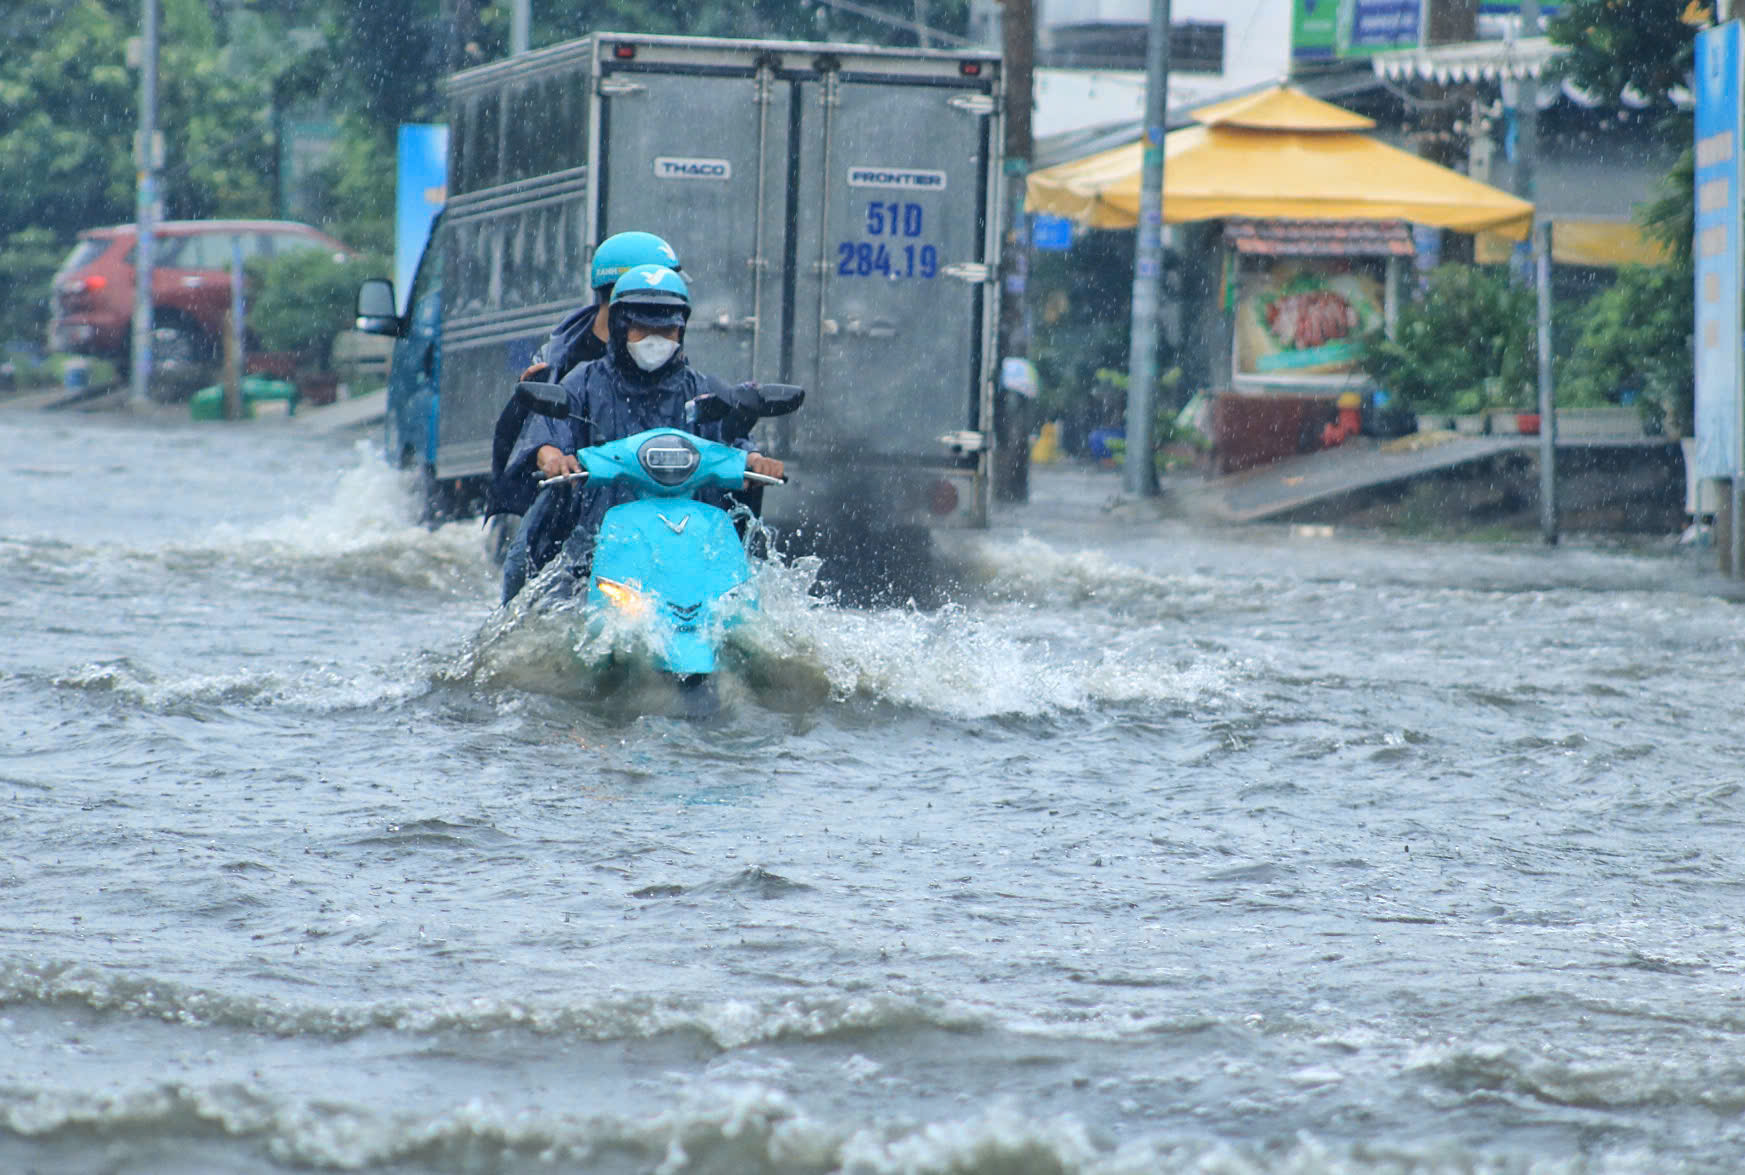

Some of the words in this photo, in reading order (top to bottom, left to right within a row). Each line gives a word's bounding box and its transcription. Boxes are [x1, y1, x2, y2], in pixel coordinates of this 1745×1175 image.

[663, 162, 725, 176] THACO
[852, 171, 942, 185] FRONTIER
[867, 202, 923, 237] 51D
[838, 242, 937, 279] 284.19
